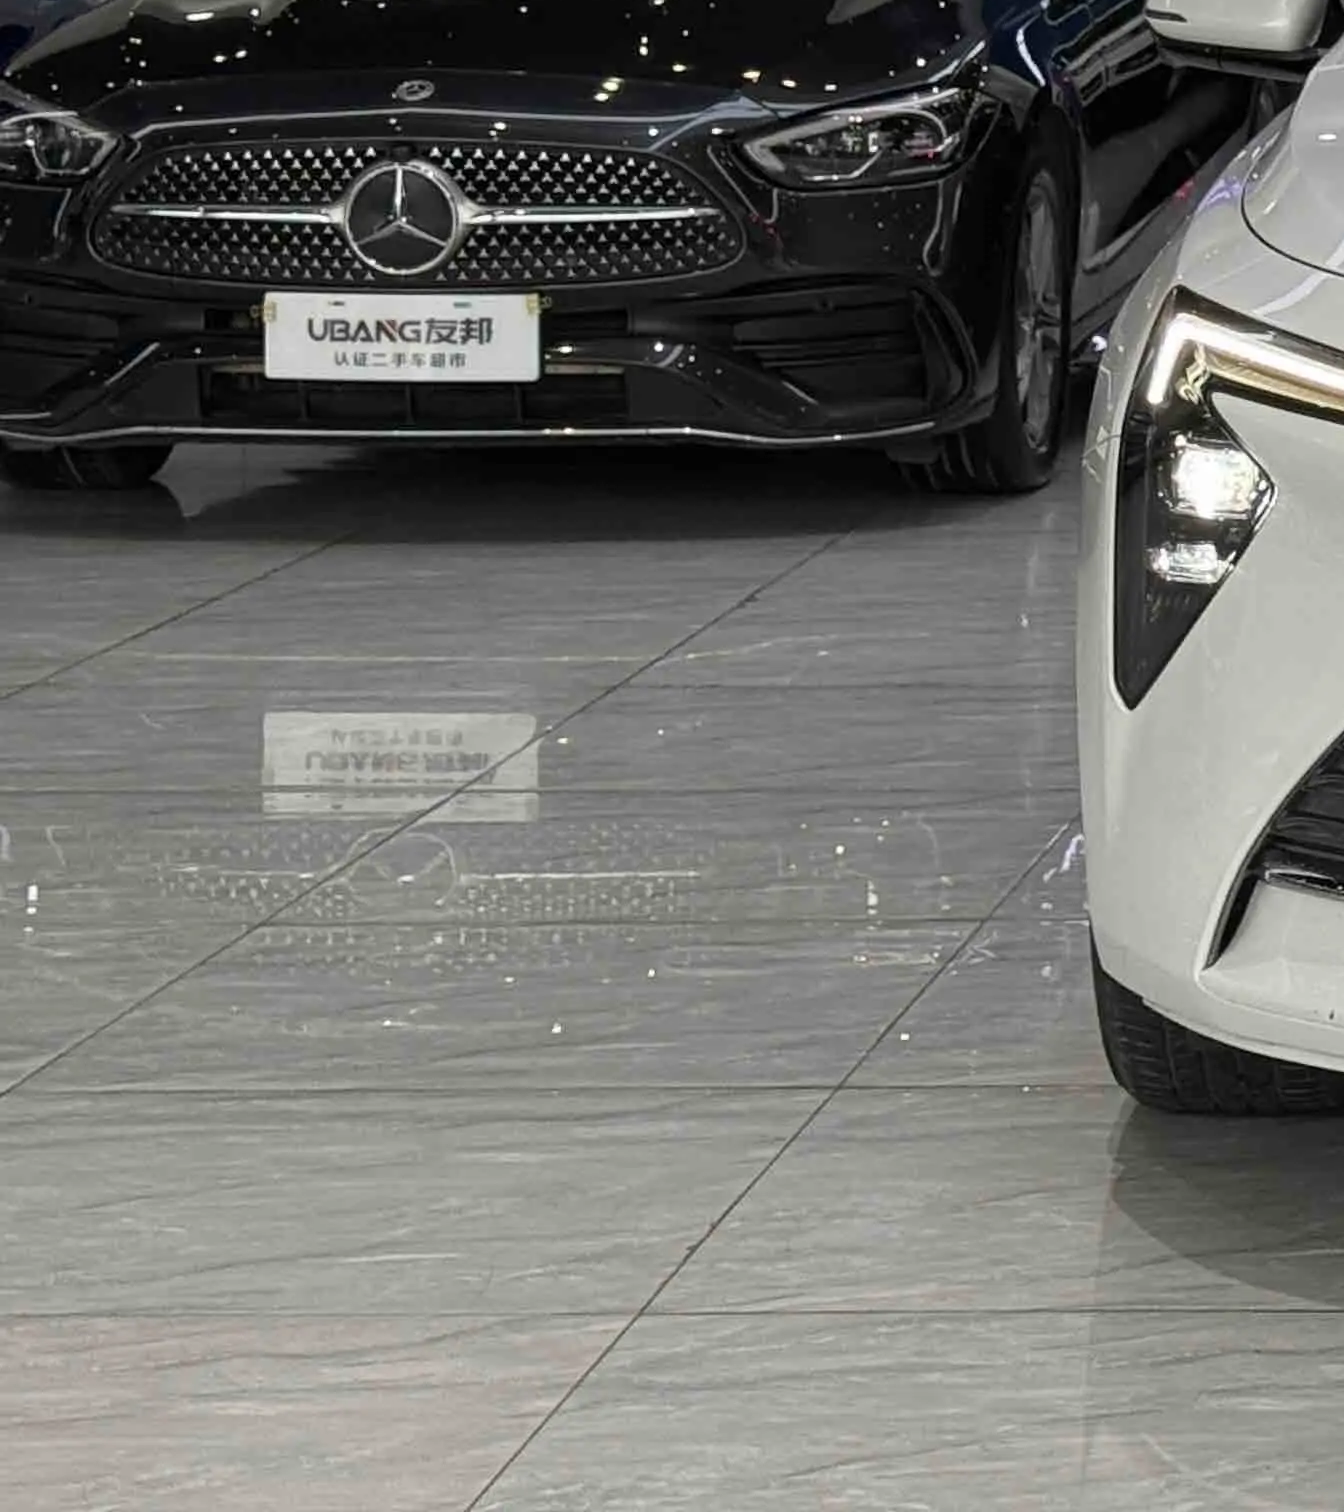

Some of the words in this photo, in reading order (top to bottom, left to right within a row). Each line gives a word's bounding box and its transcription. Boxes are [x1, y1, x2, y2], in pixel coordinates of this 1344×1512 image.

[307, 318, 494, 346] UBANG友邦
[334, 352, 467, 368] 认证二手车超市
